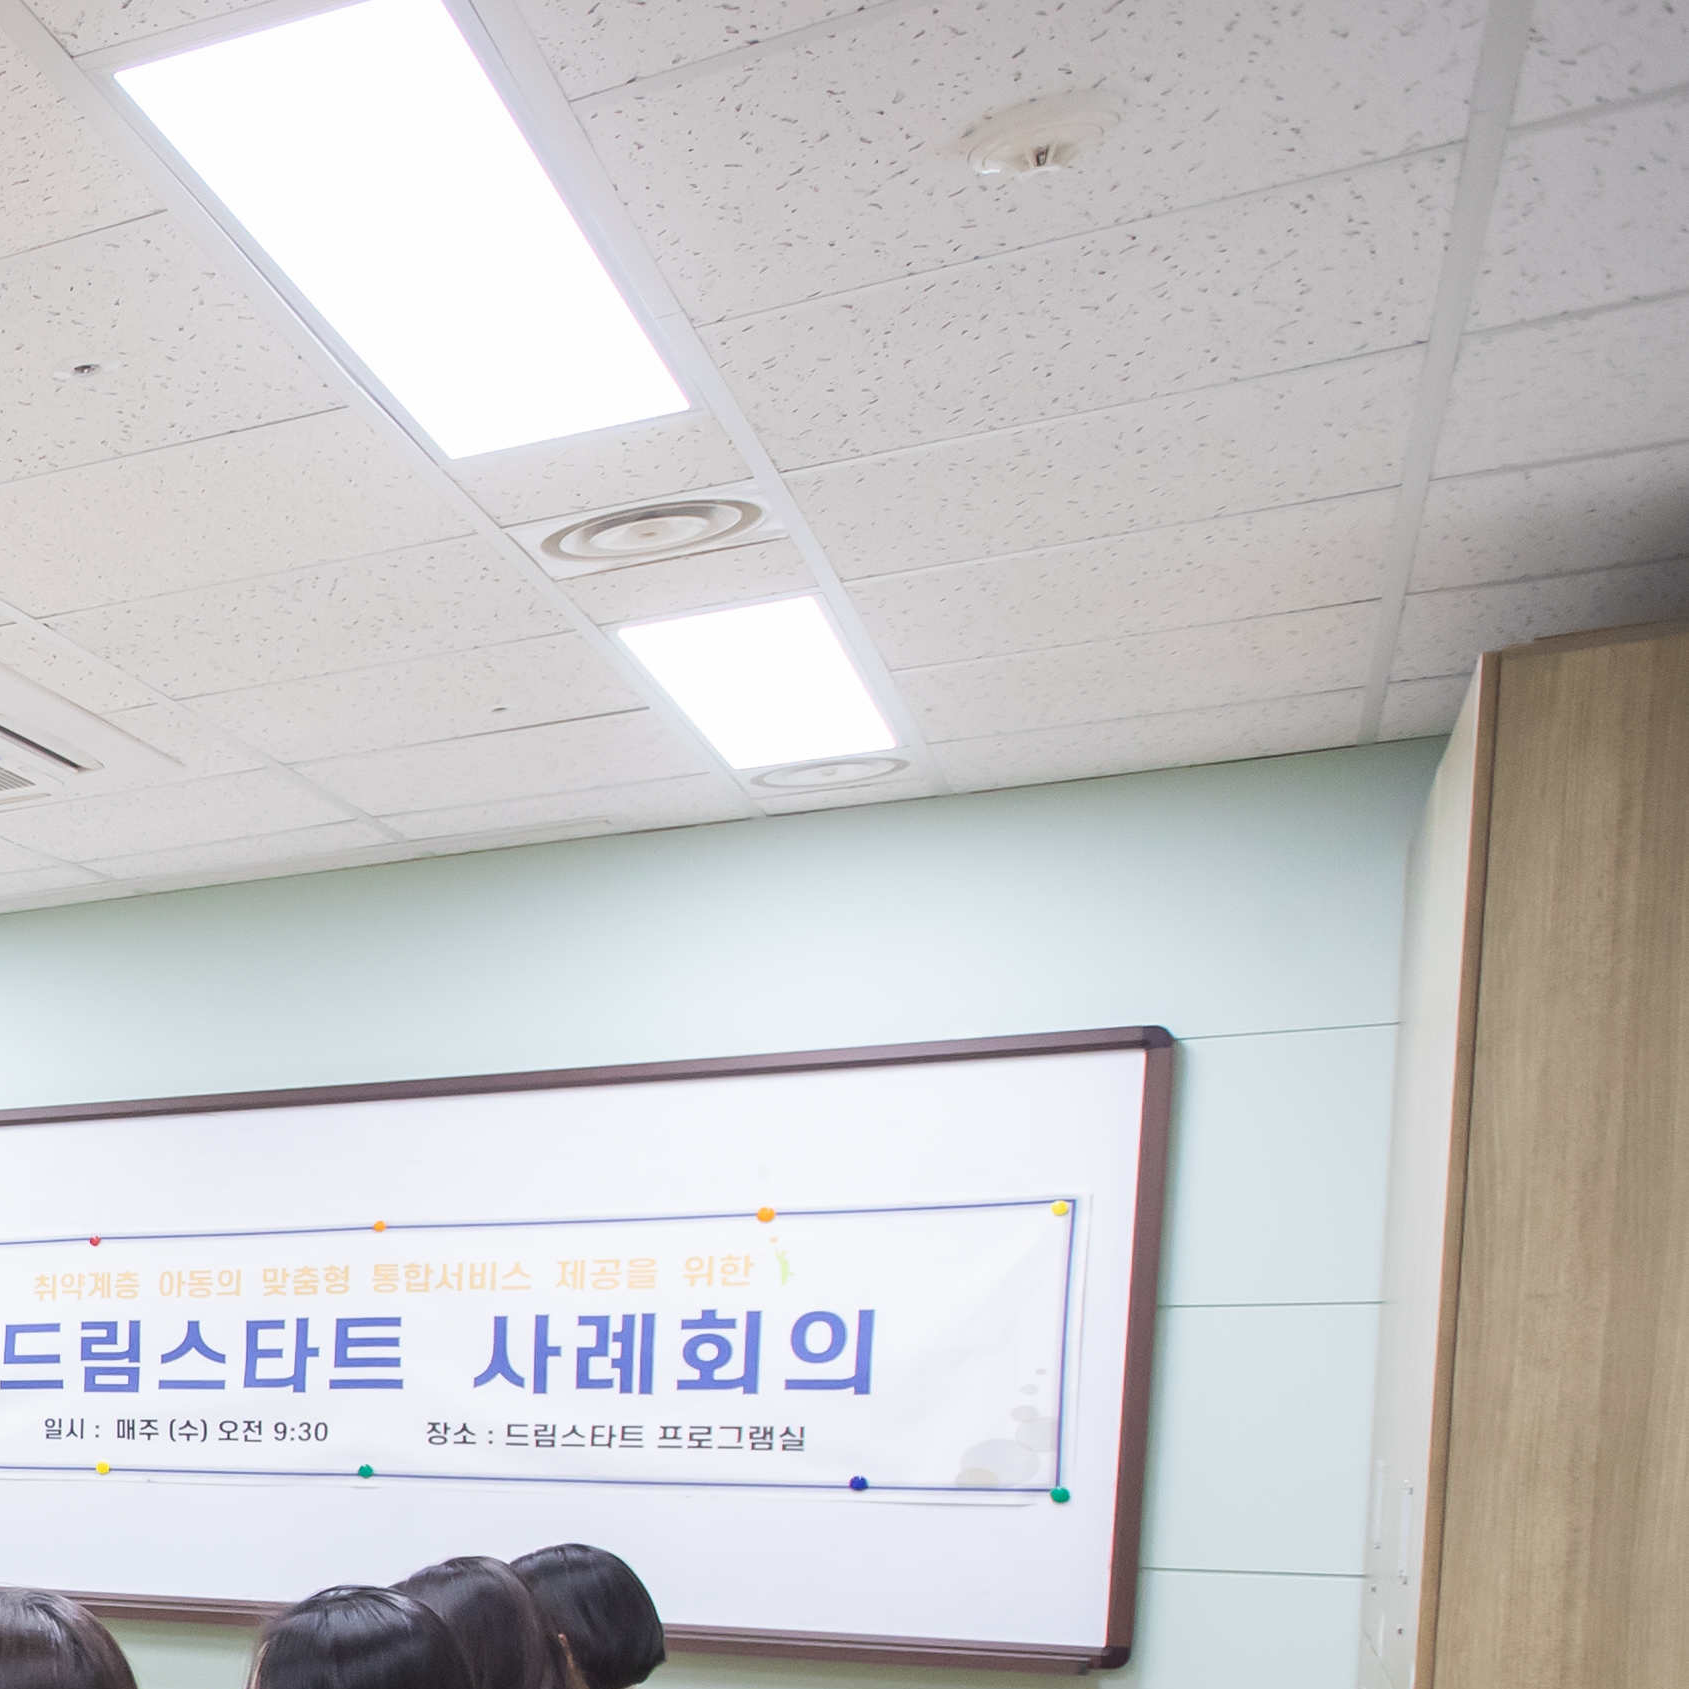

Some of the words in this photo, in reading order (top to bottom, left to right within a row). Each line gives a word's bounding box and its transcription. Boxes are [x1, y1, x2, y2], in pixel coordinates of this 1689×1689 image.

[34, 1270, 141, 1301] 취약계층
[158, 1268, 242, 1298] 아동의
[262, 1264, 351, 1296] 맞춤형
[371, 1261, 532, 1293] 통합서비스
[555, 1256, 658, 1291] 제공을
[682, 1253, 756, 1288] 위한
[472, 1307, 878, 1397] 사례회의
[44, 1417, 85, 1440] 일시
[116, 1418, 160, 1441] 매주
[168, 1418, 208, 1443] (수)
[217, 1419, 263, 1443] 오전
[273, 1421, 329, 1442] 9:30
[426, 1421, 478, 1446] 장소
[505, 1424, 645, 1449] 드림스타트
[657, 1425, 806, 1452] 프로그램실
